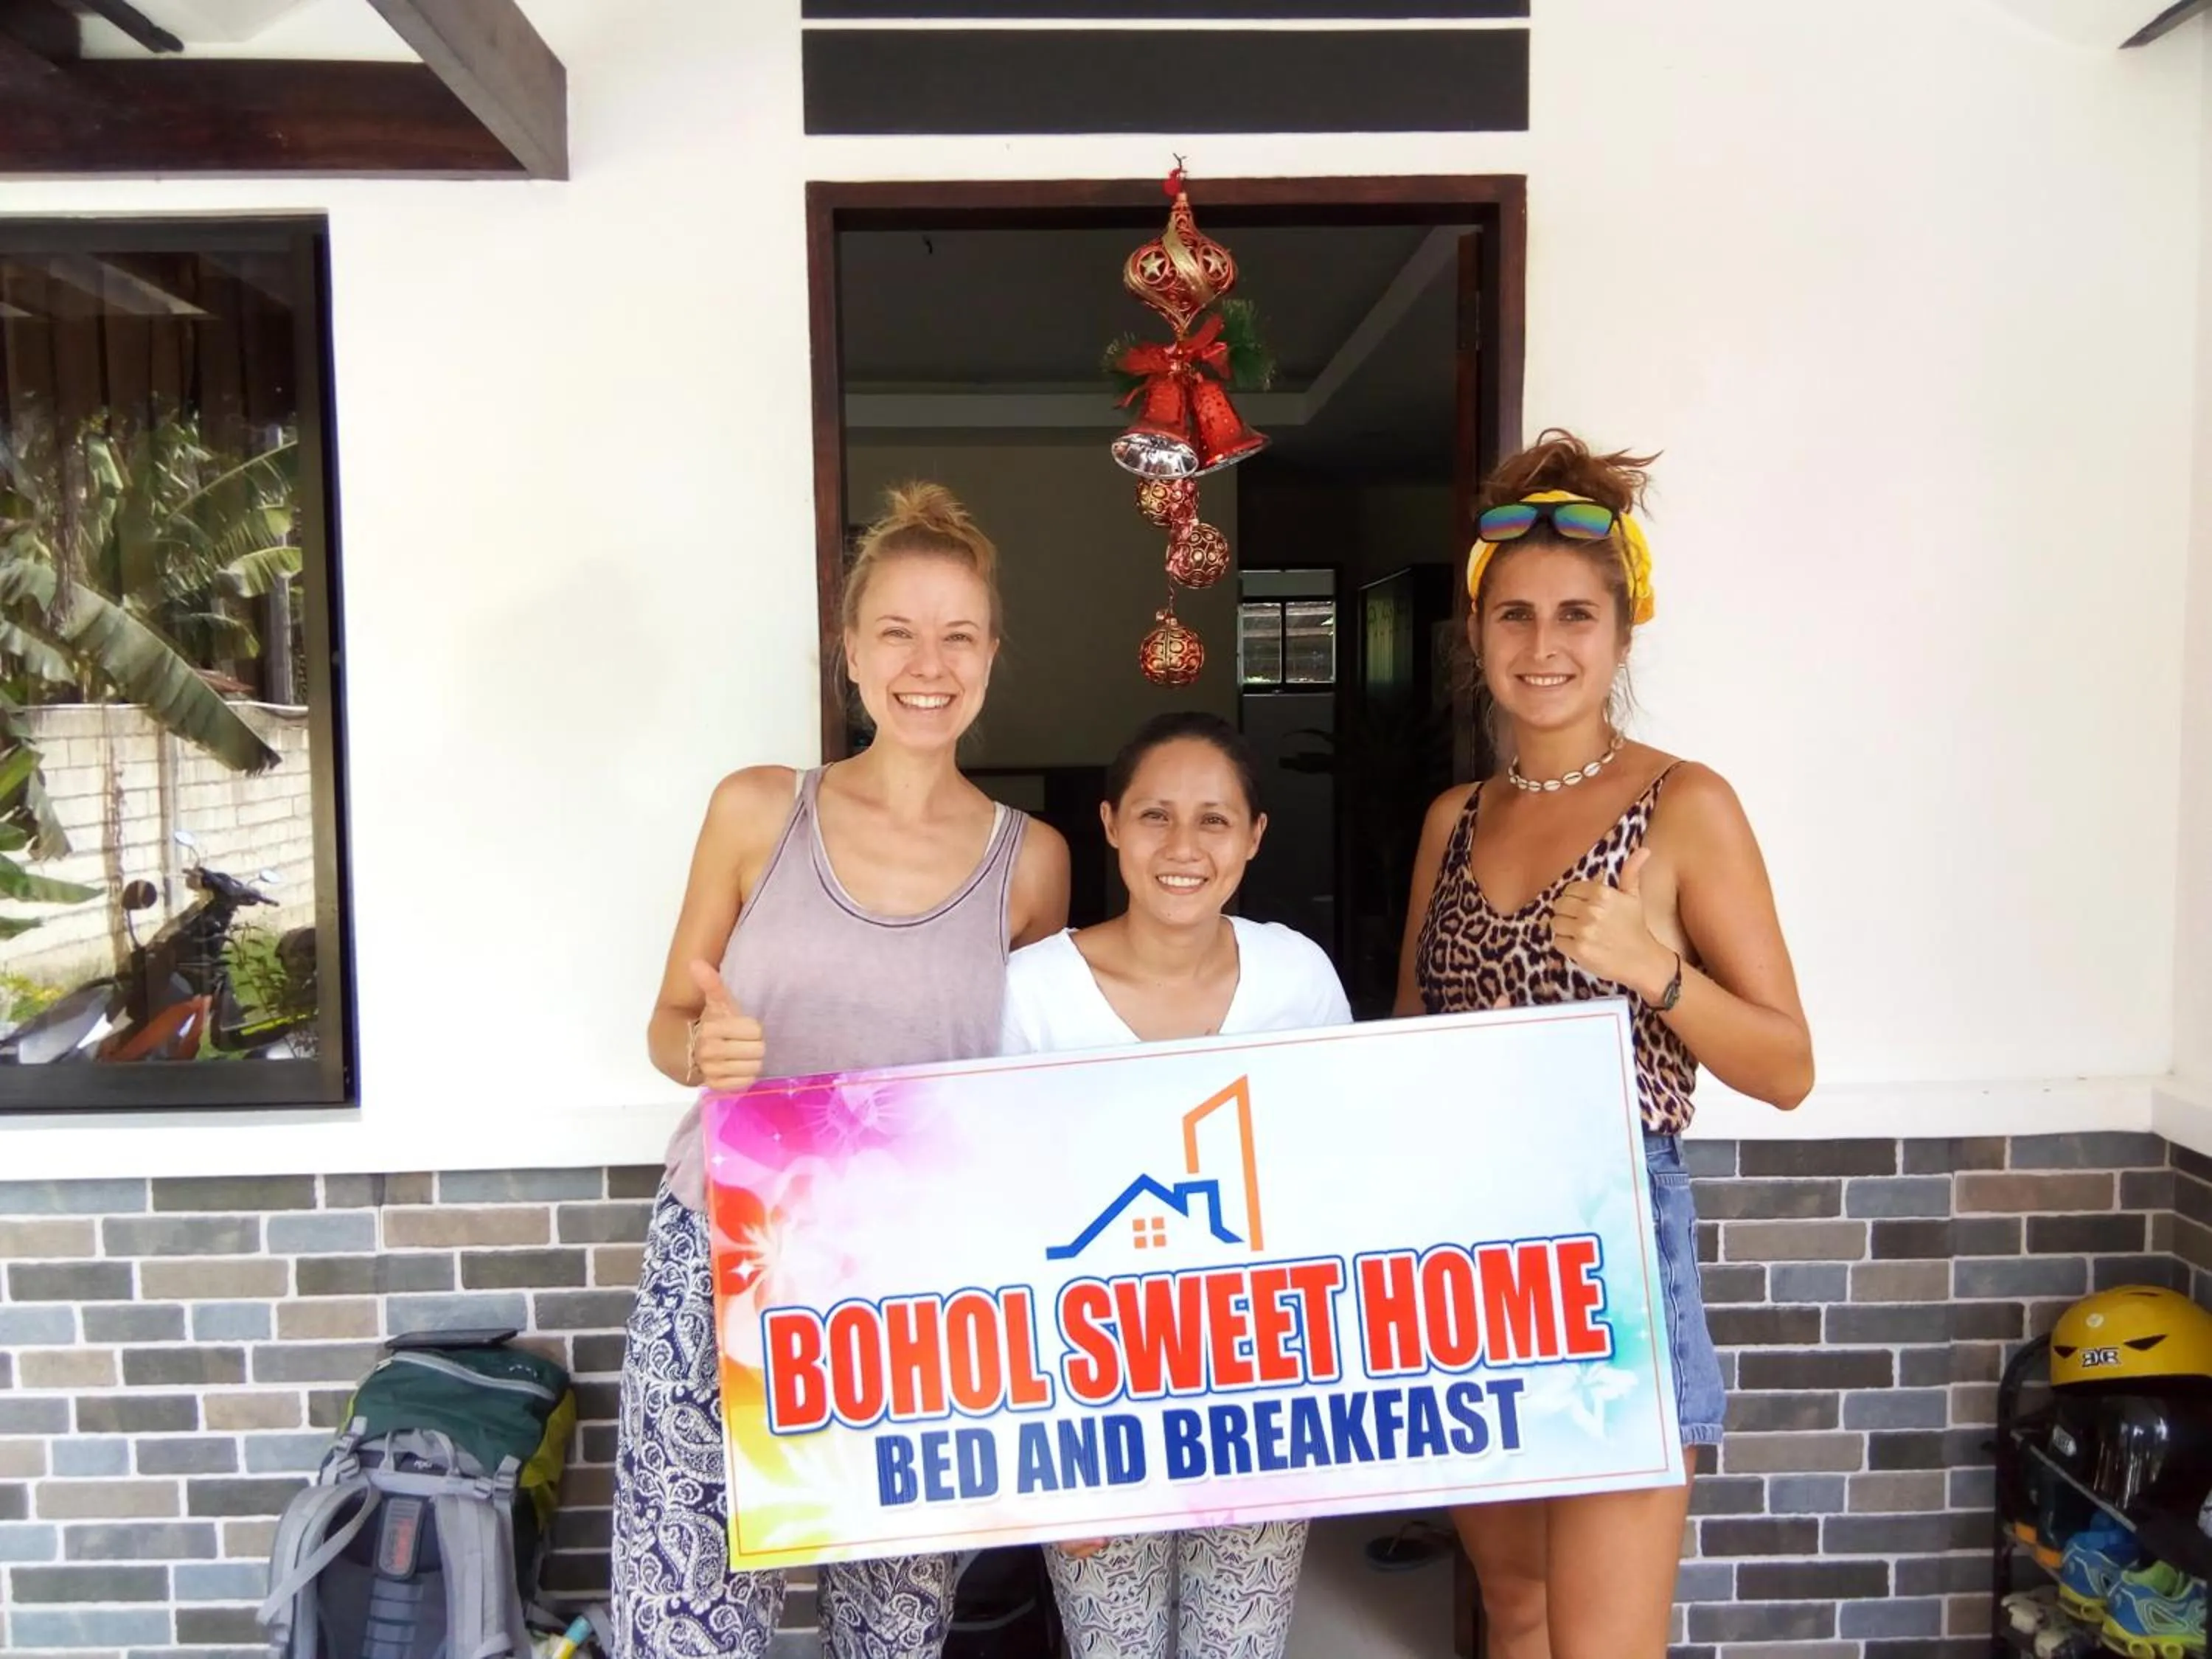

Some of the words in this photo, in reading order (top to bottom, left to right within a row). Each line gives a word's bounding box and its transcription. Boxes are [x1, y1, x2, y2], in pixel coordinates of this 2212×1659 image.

[765, 1290, 1052, 1430] BOHOL
[1060, 1259, 1342, 1402] SWEET
[1358, 1237, 1610, 1375] HOME
[875, 1427, 999, 1507] BED
[1017, 1413, 1147, 1494] AND
[1162, 1377, 1524, 1481] BREAKFAST
